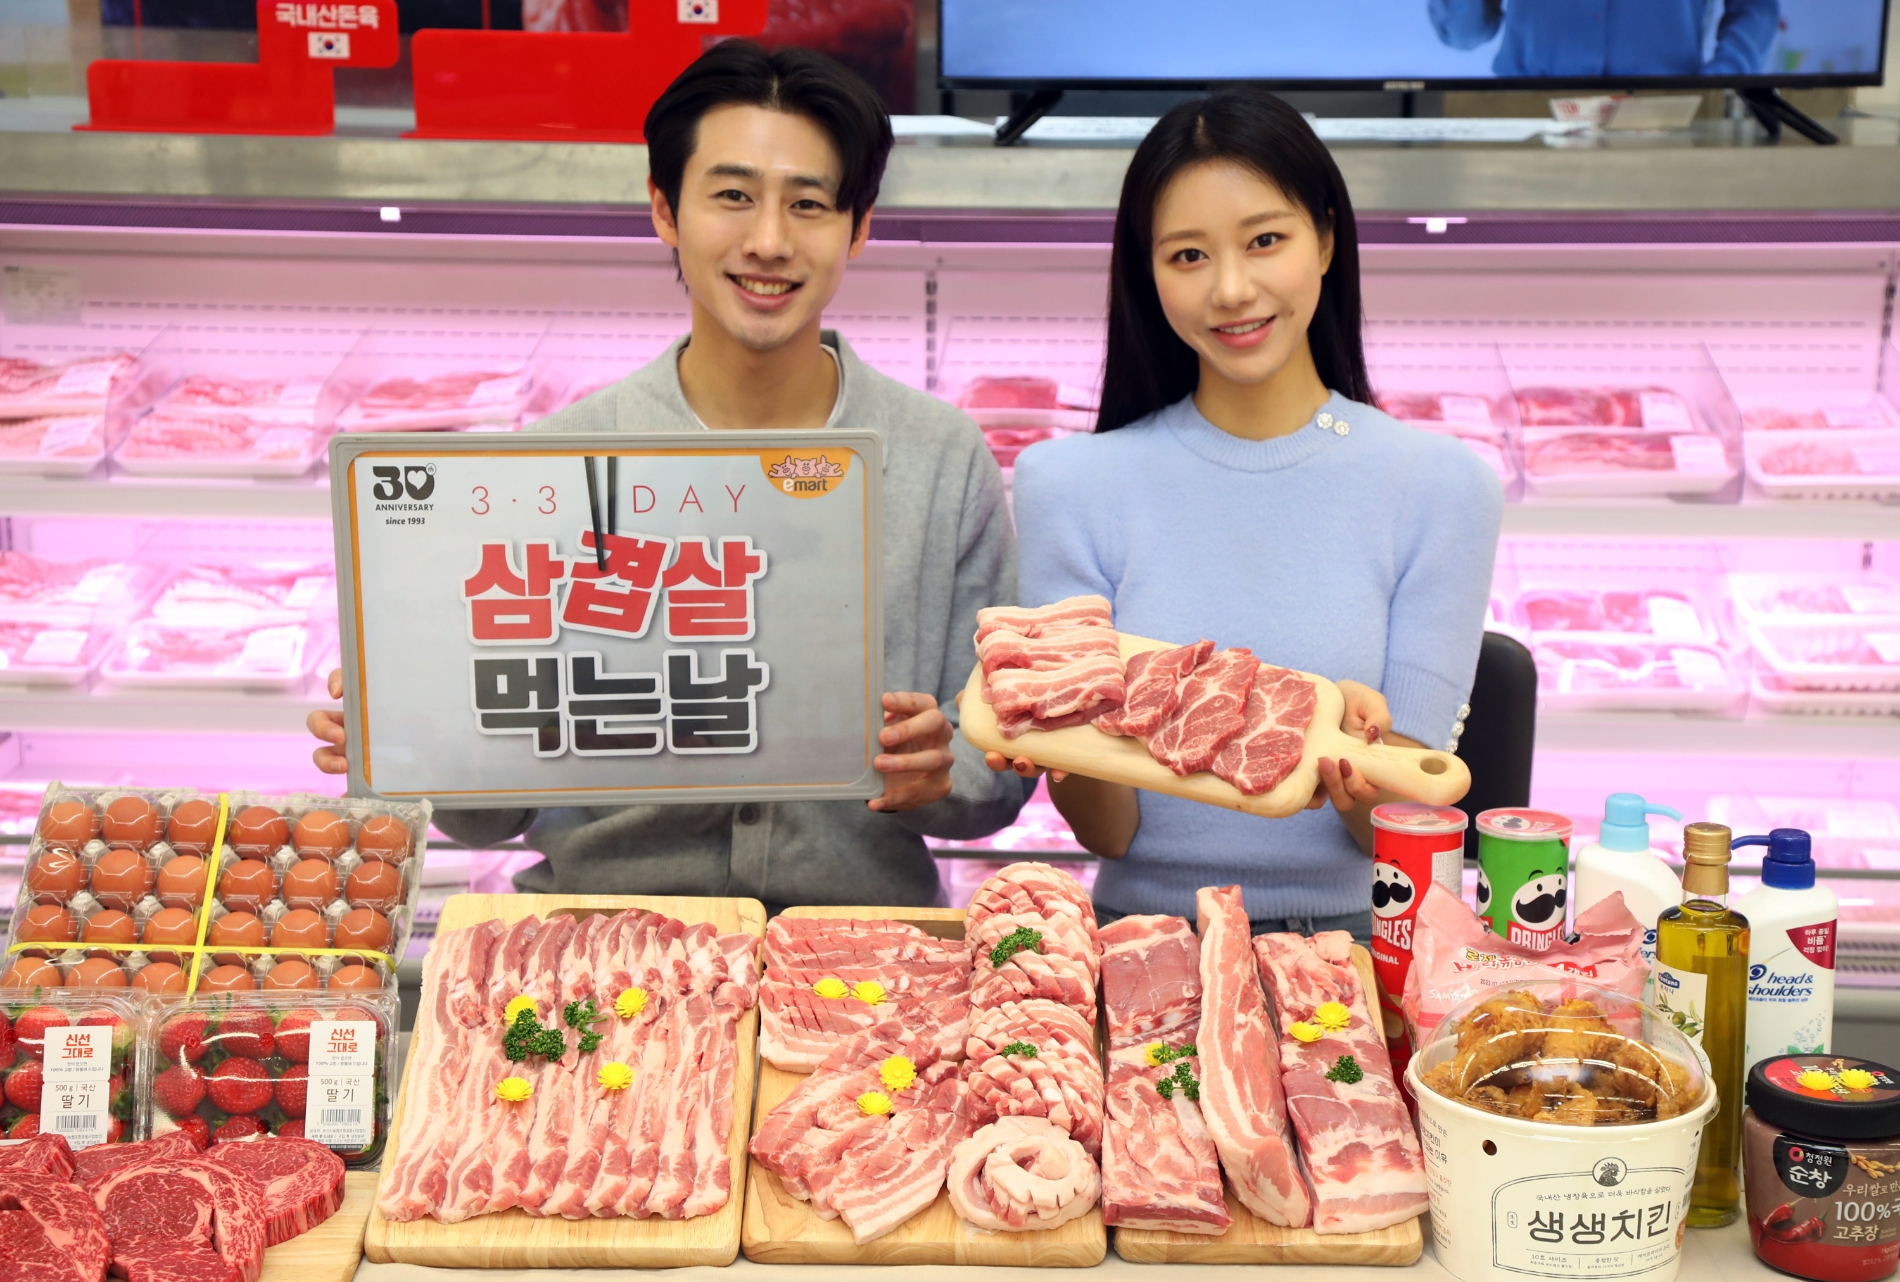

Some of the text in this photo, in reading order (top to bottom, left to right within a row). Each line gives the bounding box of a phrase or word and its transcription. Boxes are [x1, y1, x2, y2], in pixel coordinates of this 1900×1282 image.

[275, 2, 380, 30] 국내산돈육
[782, 478, 828, 492] emart
[632, 484, 746, 513] DAY
[375, 503, 434, 511] ANNIVERSARY
[385, 517, 426, 525] since 1993
[464, 530, 761, 640] 삼겹살
[1767, 972, 1807, 984] head
[66, 1033, 91, 1047] 신선
[330, 1028, 355, 1041] 신선
[61, 1047, 94, 1059] 그대로
[326, 1042, 358, 1053] 그대로
[81, 1083, 96, 1092] 국산
[345, 1078, 360, 1086] 국산
[1805, 1152, 1833, 1167] 청정원
[1788, 1165, 1833, 1189] 순창
[1536, 1194, 1561, 1202] 국내산
[1834, 1200, 1891, 1222] 100%
[1527, 1200, 1672, 1245] 생생치킨
[1833, 1224, 1880, 1242] 고추장
